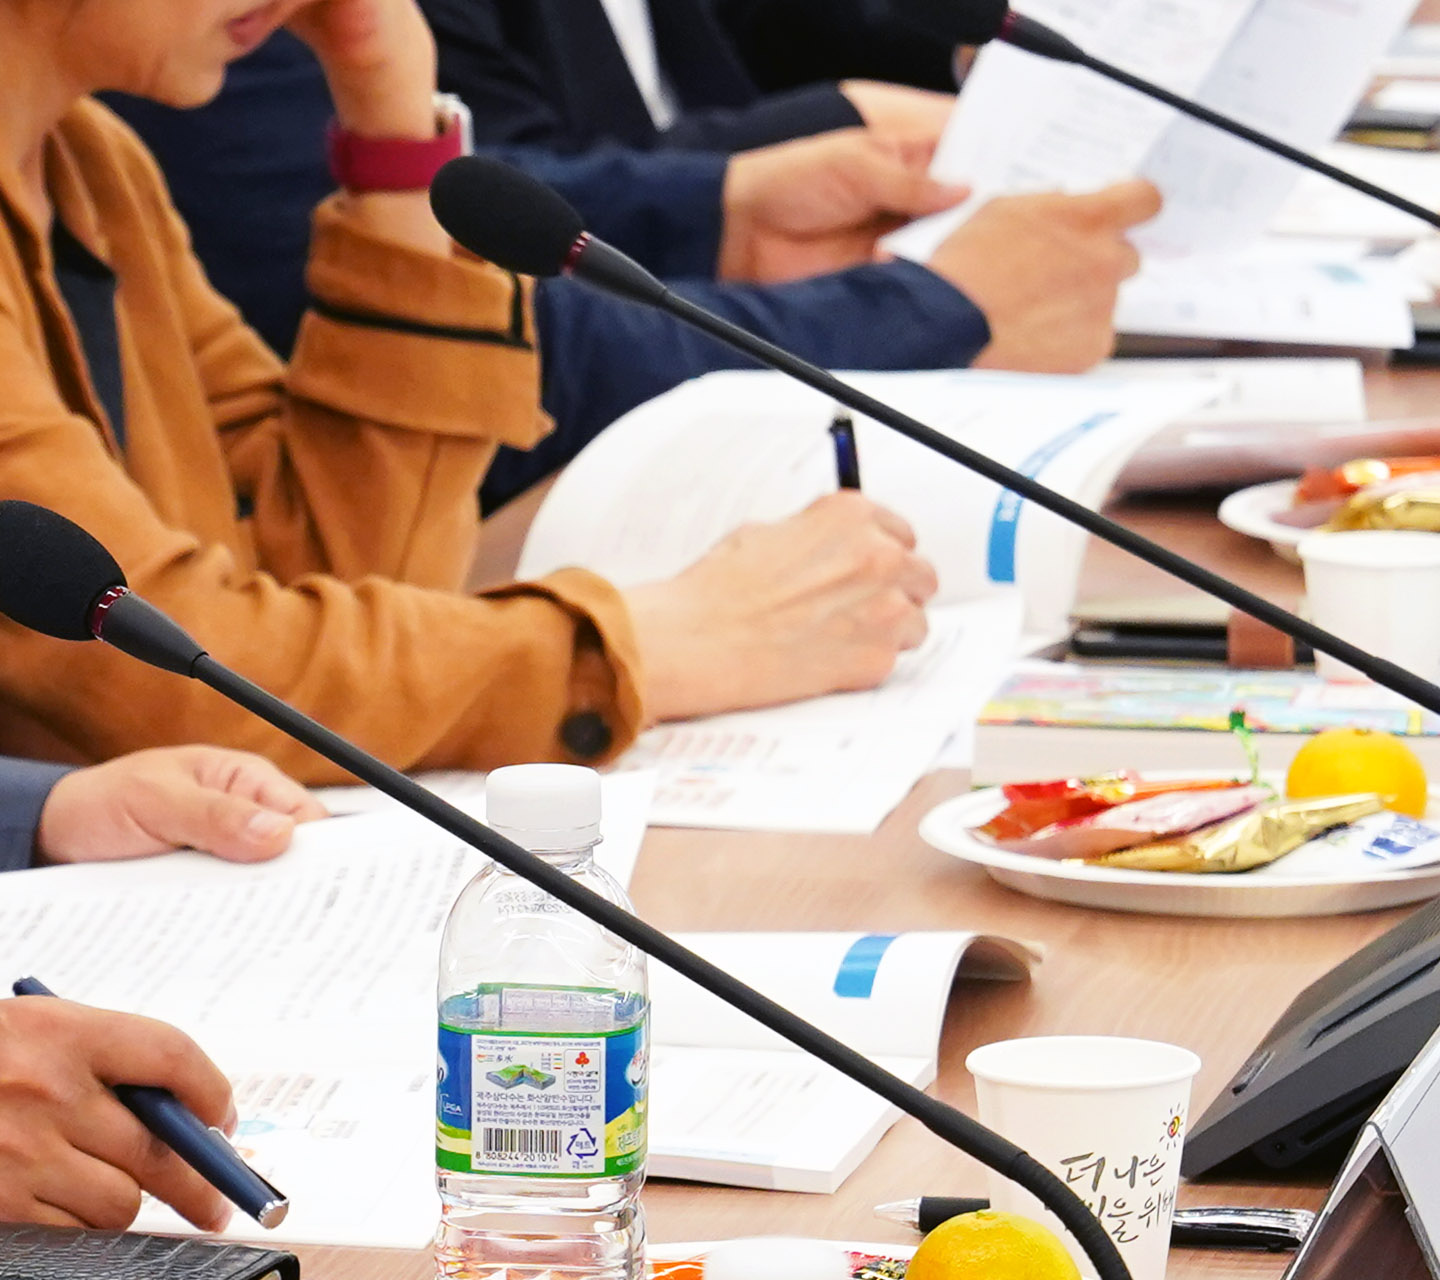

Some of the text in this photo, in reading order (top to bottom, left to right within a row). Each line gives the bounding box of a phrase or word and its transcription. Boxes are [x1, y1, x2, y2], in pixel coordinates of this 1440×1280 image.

[475, 1091, 596, 1103] 제주삼다수는 화산암반수입니다.
[1059, 1151, 1166, 1192] 더 나은
